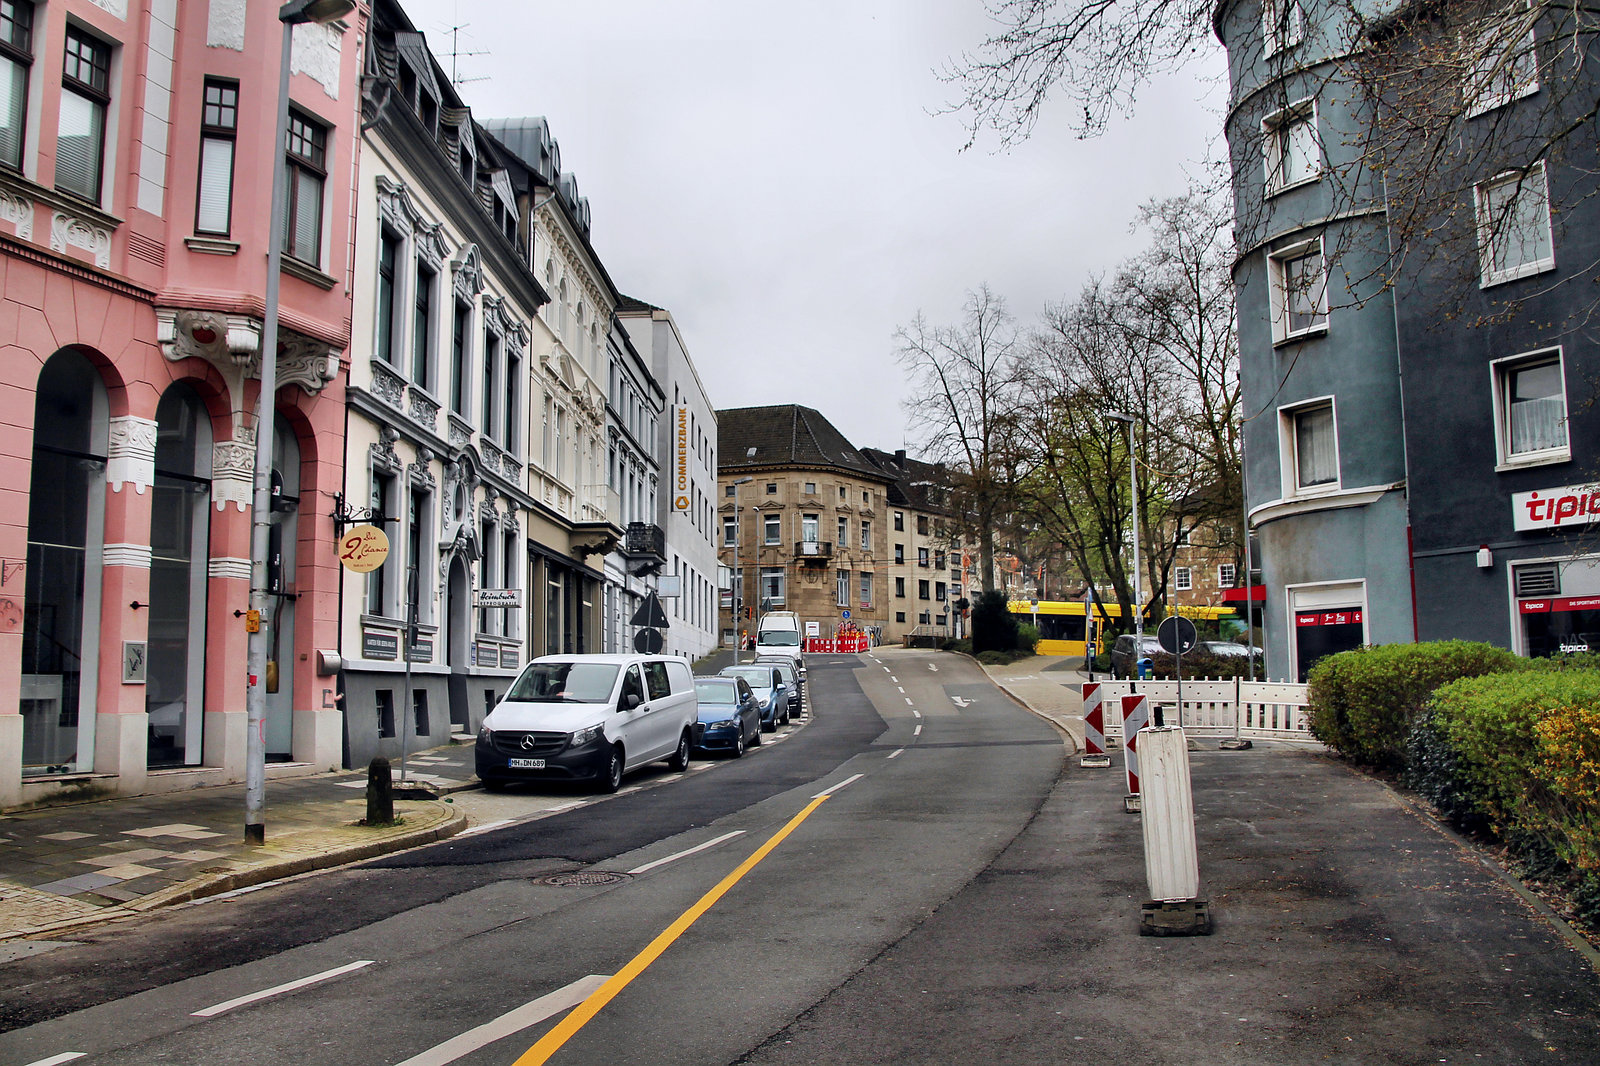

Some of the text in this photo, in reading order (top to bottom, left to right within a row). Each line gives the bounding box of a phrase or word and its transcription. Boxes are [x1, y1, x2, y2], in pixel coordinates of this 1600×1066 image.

[678, 408, 687, 491] COMMERZBANK
[341, 537, 388, 560] 2. Chance
[480, 592, 517, 600] Heimbuch
[1525, 602, 1544, 610] tipico
[1560, 643, 1588, 653] tipico
